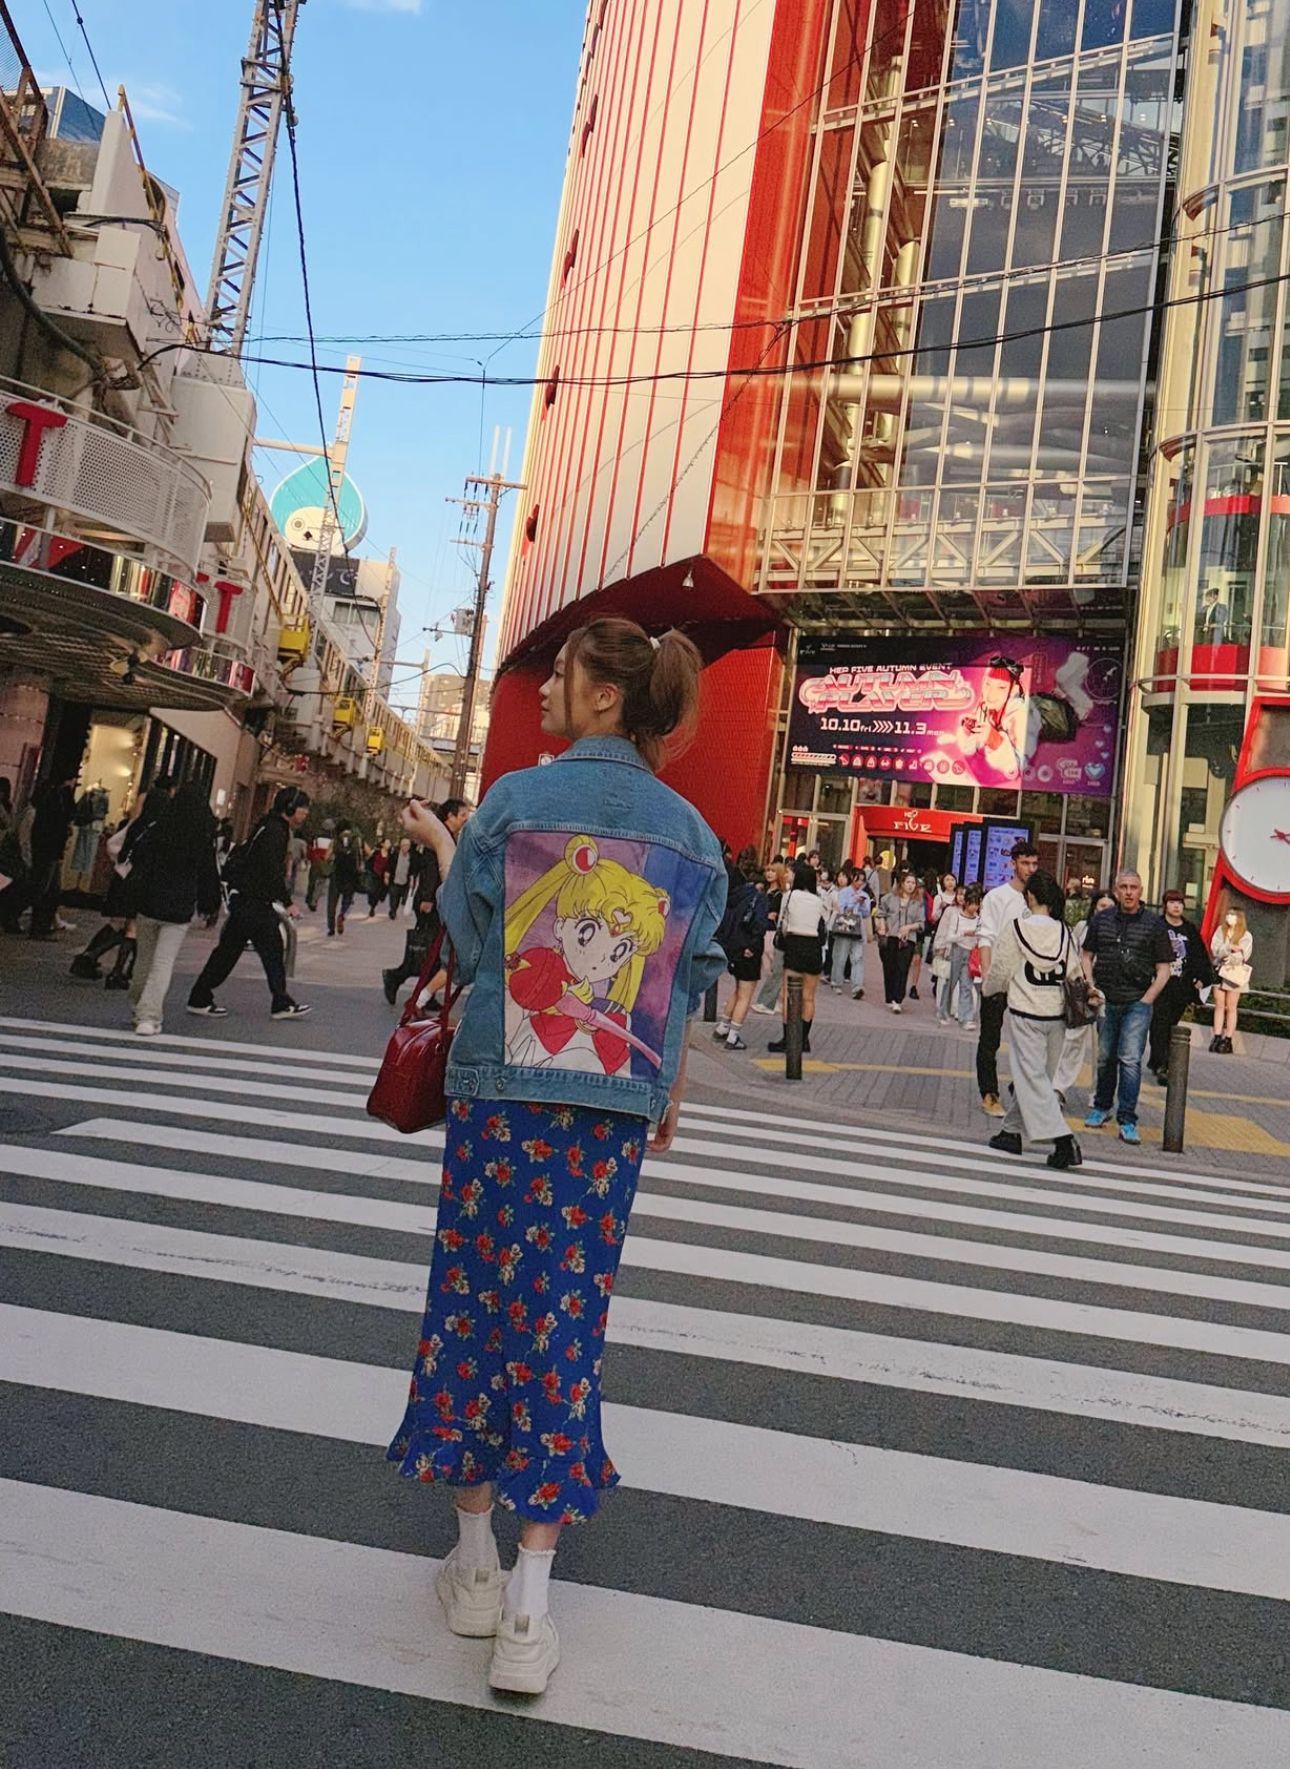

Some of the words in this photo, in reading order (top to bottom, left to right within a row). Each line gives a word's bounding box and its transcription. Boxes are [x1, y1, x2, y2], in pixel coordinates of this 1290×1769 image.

[5, 402, 68, 487] T
[851, 665, 873, 673] FIVE
[876, 664, 917, 672] AUTUMN
[919, 662, 952, 671] EVENT
[894, 817, 933, 833] FIVE
